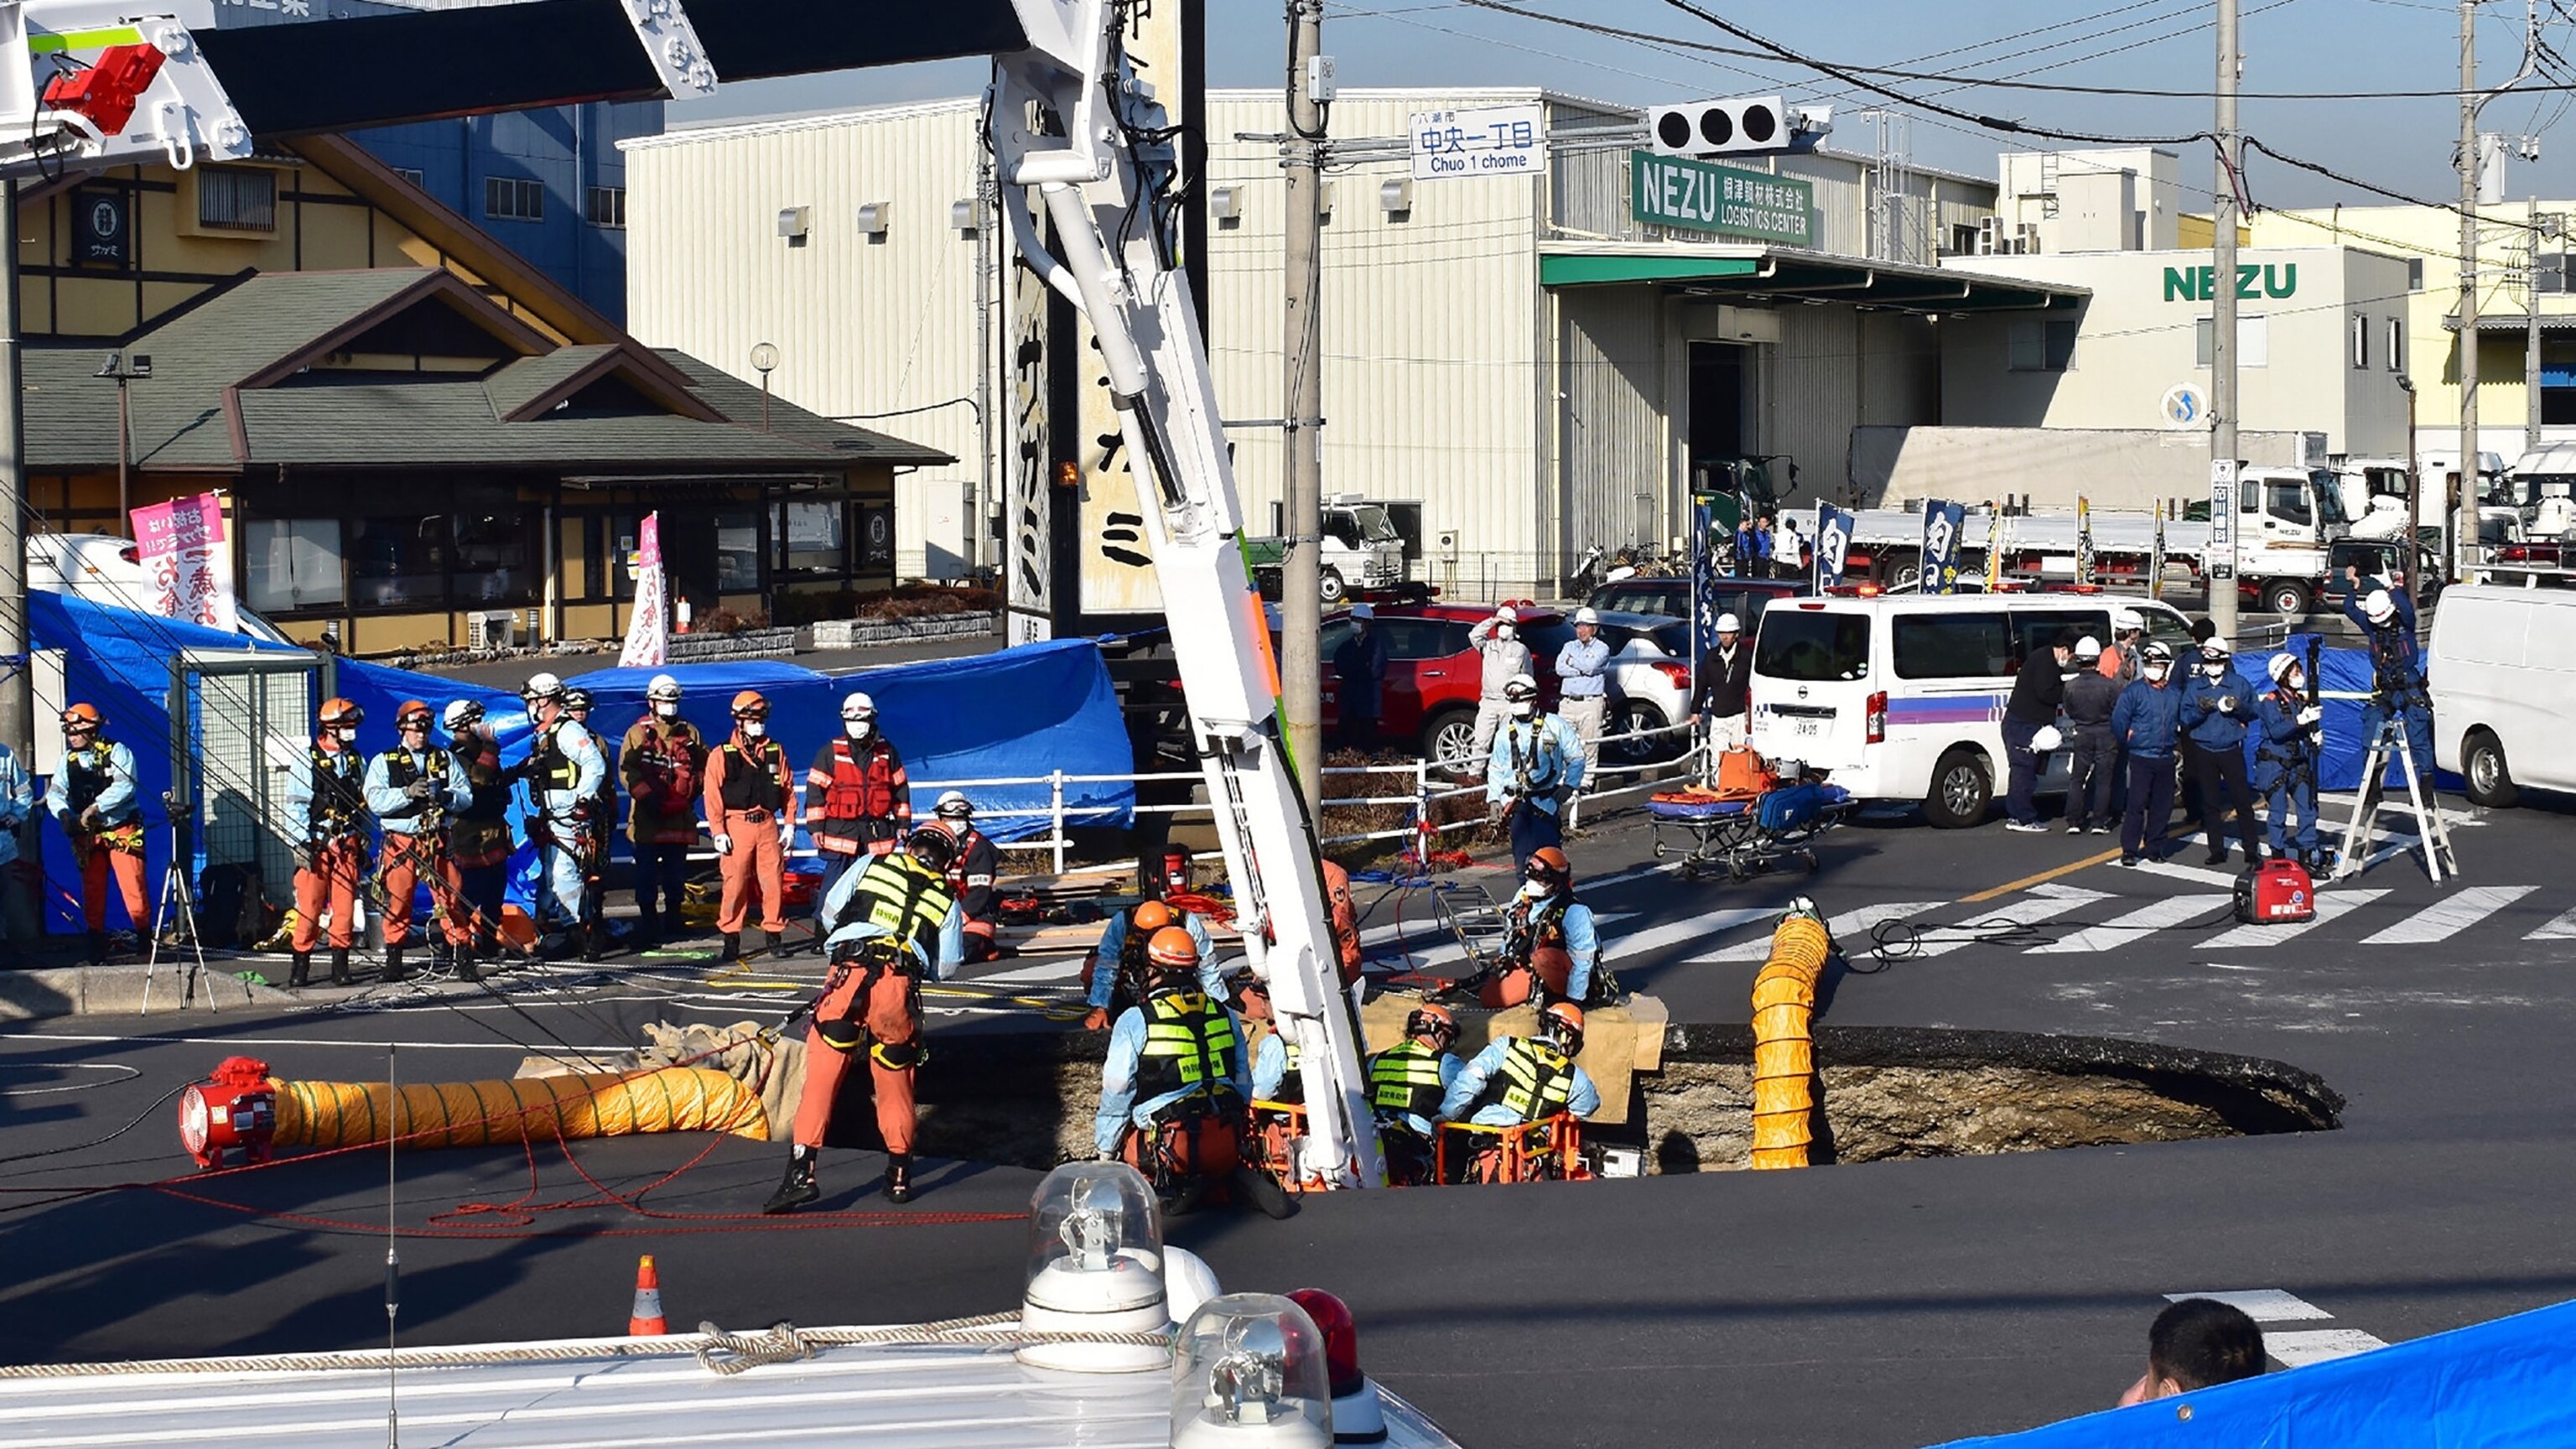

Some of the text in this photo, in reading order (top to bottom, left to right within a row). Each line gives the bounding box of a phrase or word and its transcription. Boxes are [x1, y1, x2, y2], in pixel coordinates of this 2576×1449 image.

[1420, 122, 1532, 155] 中央一丁目
[1431, 153, 1527, 172] Chuo 1 chome
[1644, 161, 1715, 221] NEZU
[1722, 204, 1806, 236] LOGISTICS CENTER
[2164, 263, 2296, 302] NEZU
